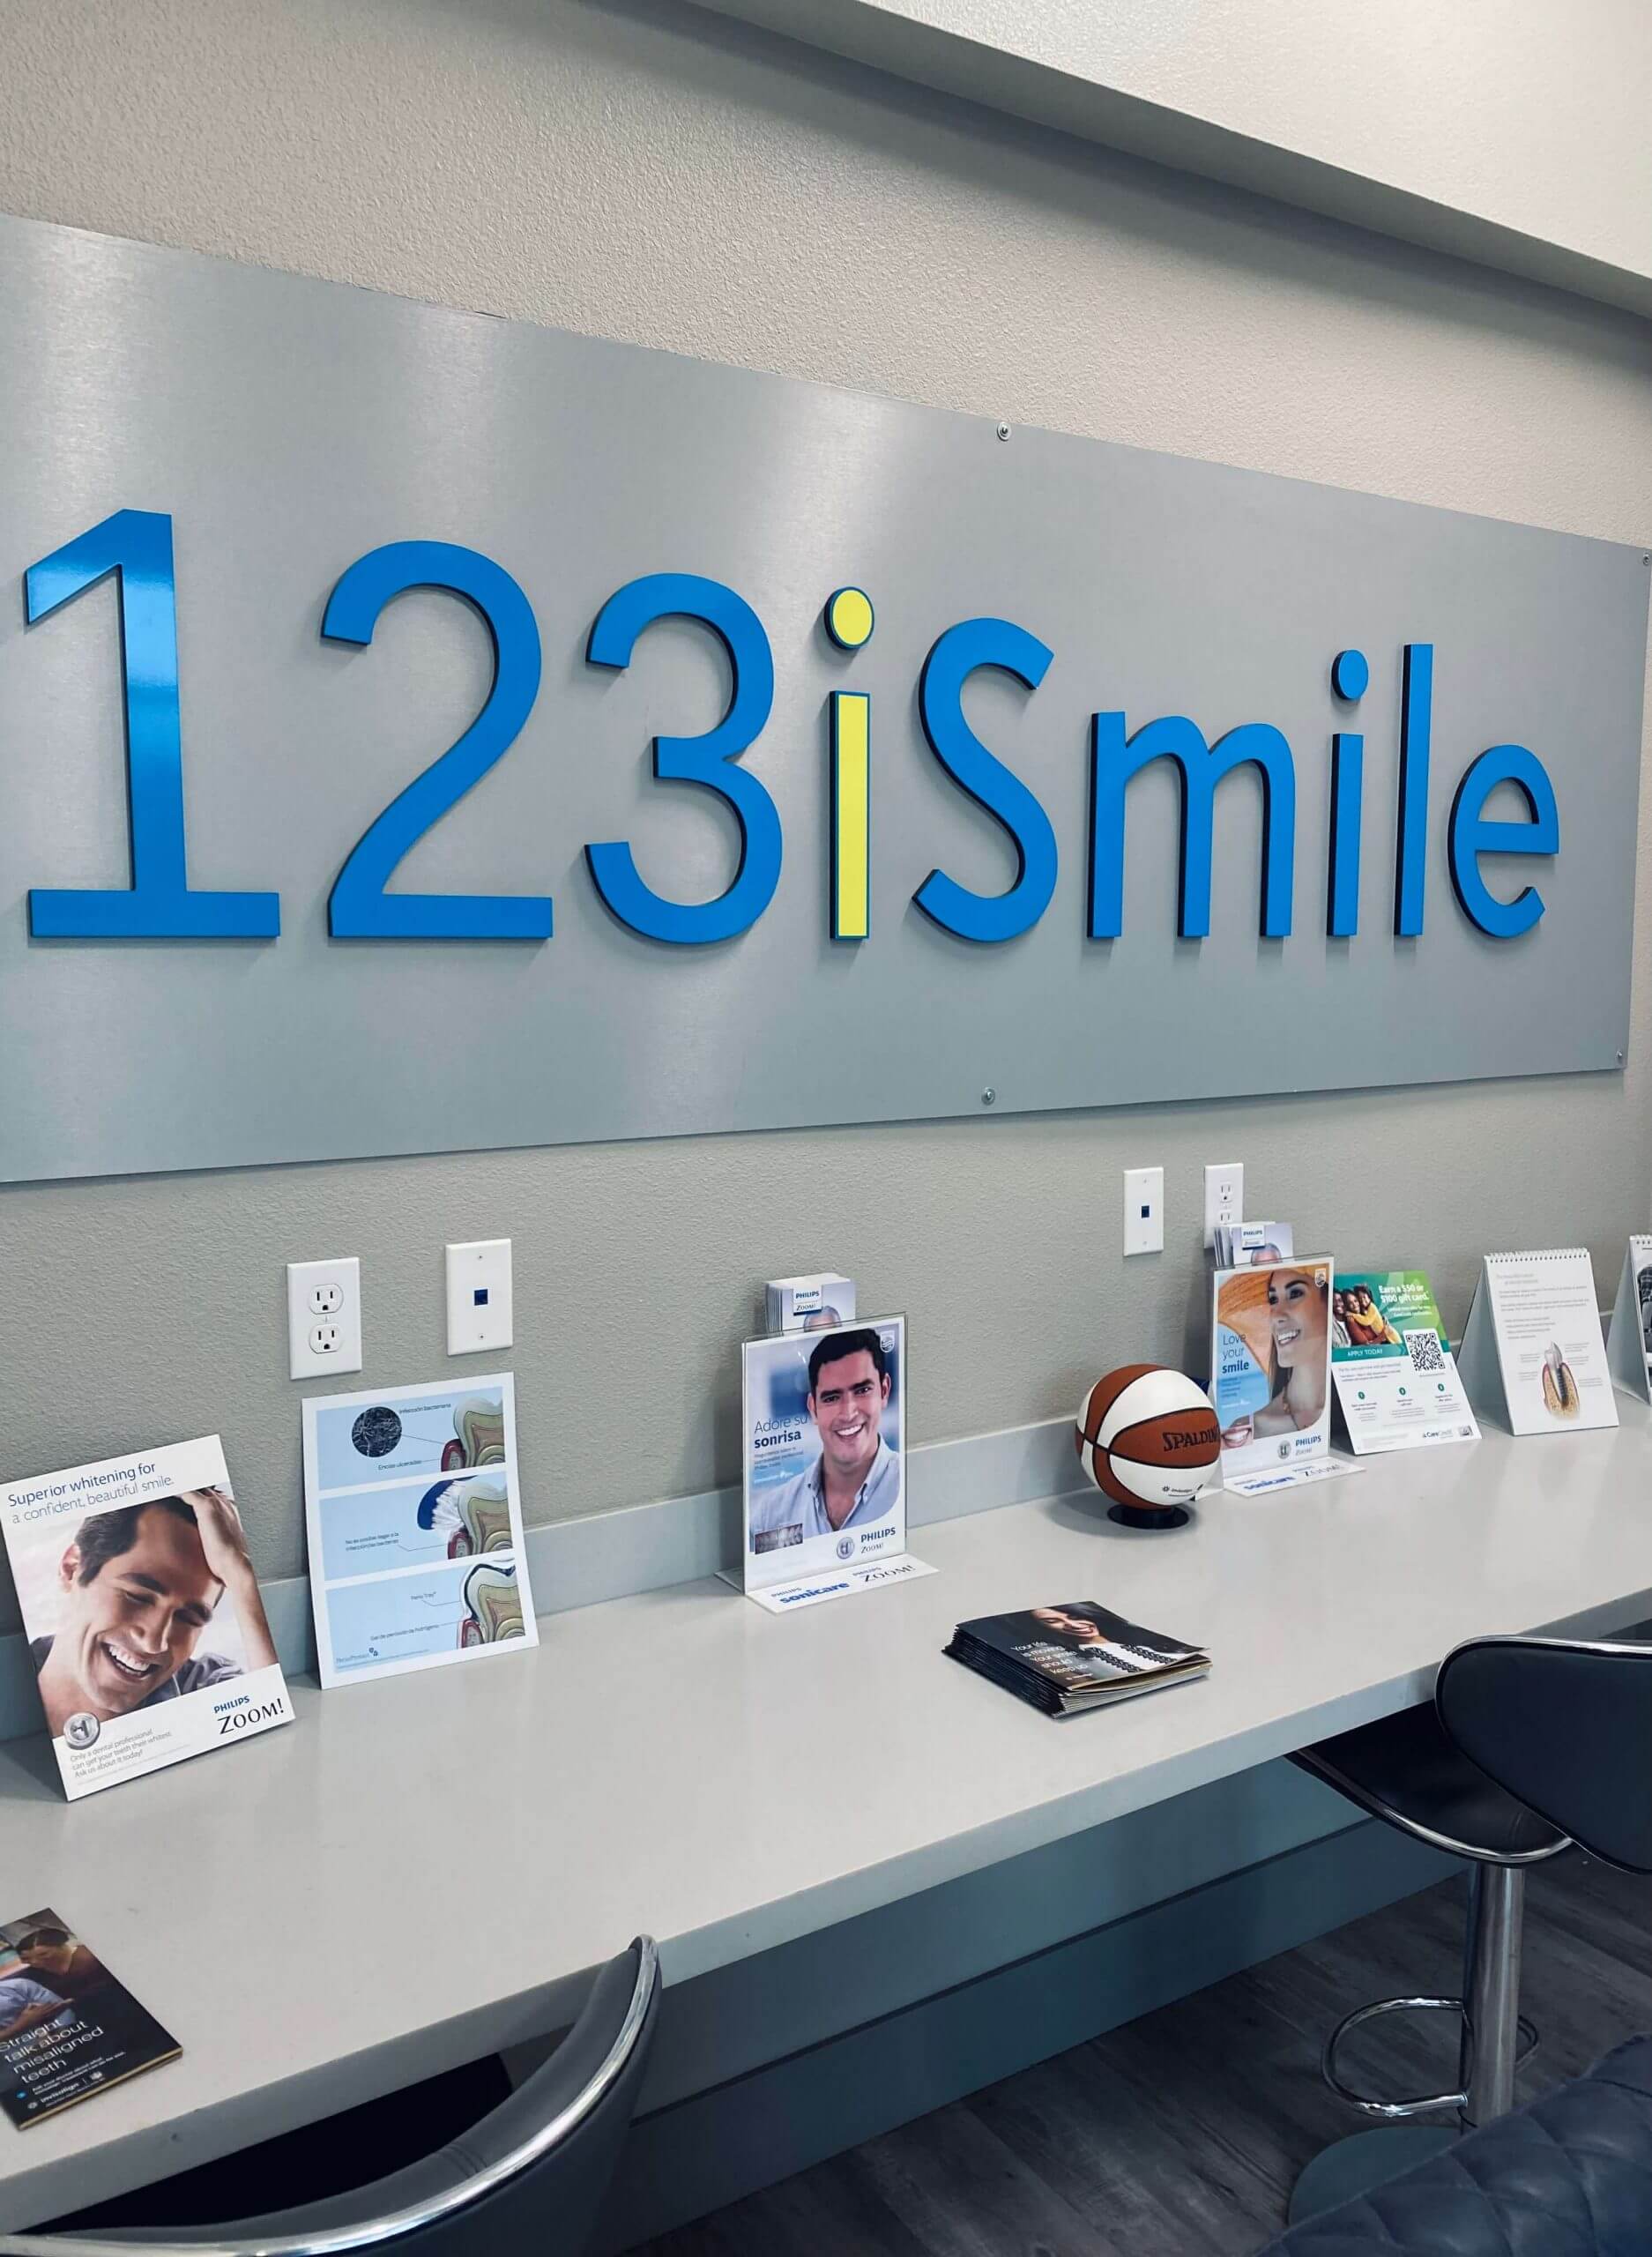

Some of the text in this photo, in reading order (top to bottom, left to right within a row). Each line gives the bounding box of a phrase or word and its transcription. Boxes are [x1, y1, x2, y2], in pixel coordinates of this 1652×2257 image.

[1223, 1334, 1246, 1345] Love
[1223, 1347, 1245, 1361] your
[1222, 1359, 1249, 1374] smile
[755, 1415, 808, 1434] Adore su
[755, 1430, 801, 1449] sonrisa
[1163, 1426, 1218, 1452] SPALDIN
[1295, 1435, 1321, 1447] PHILIPS
[8, 1463, 156, 1507] Superior whitening for
[12, 1475, 175, 1523] a confident, beautiful smile.
[860, 1527, 896, 1543] PHILIPS
[864, 1565, 916, 1583] ZOOM!
[779, 1582, 851, 1604] sonicare
[213, 1695, 250, 1714] PHILIPS
[217, 1698, 285, 1734] ZOOM!
[0, 2019, 63, 2052] Straight
[4, 2020, 89, 2063] talk about
[13, 2026, 104, 2074] misaligned
[21, 2059, 68, 2083] teeth
